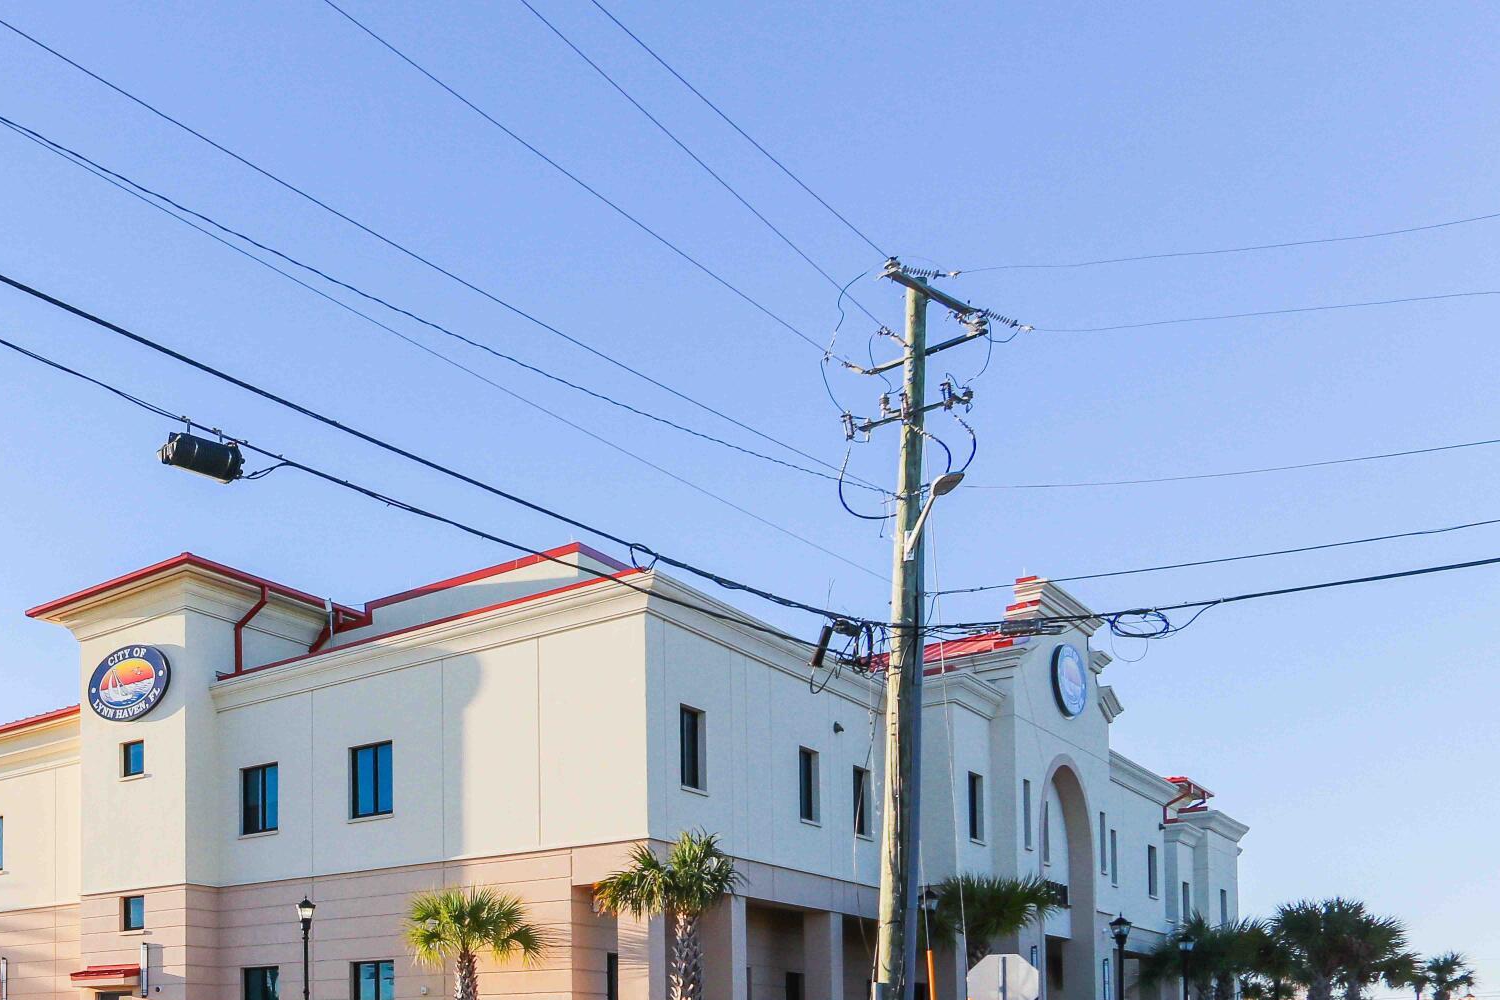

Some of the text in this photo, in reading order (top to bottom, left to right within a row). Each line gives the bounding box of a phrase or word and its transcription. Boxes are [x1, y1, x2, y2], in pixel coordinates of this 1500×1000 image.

[108, 648, 146, 666] CITY OF
[93, 688, 160, 718] LYNN HAVEN, FL
